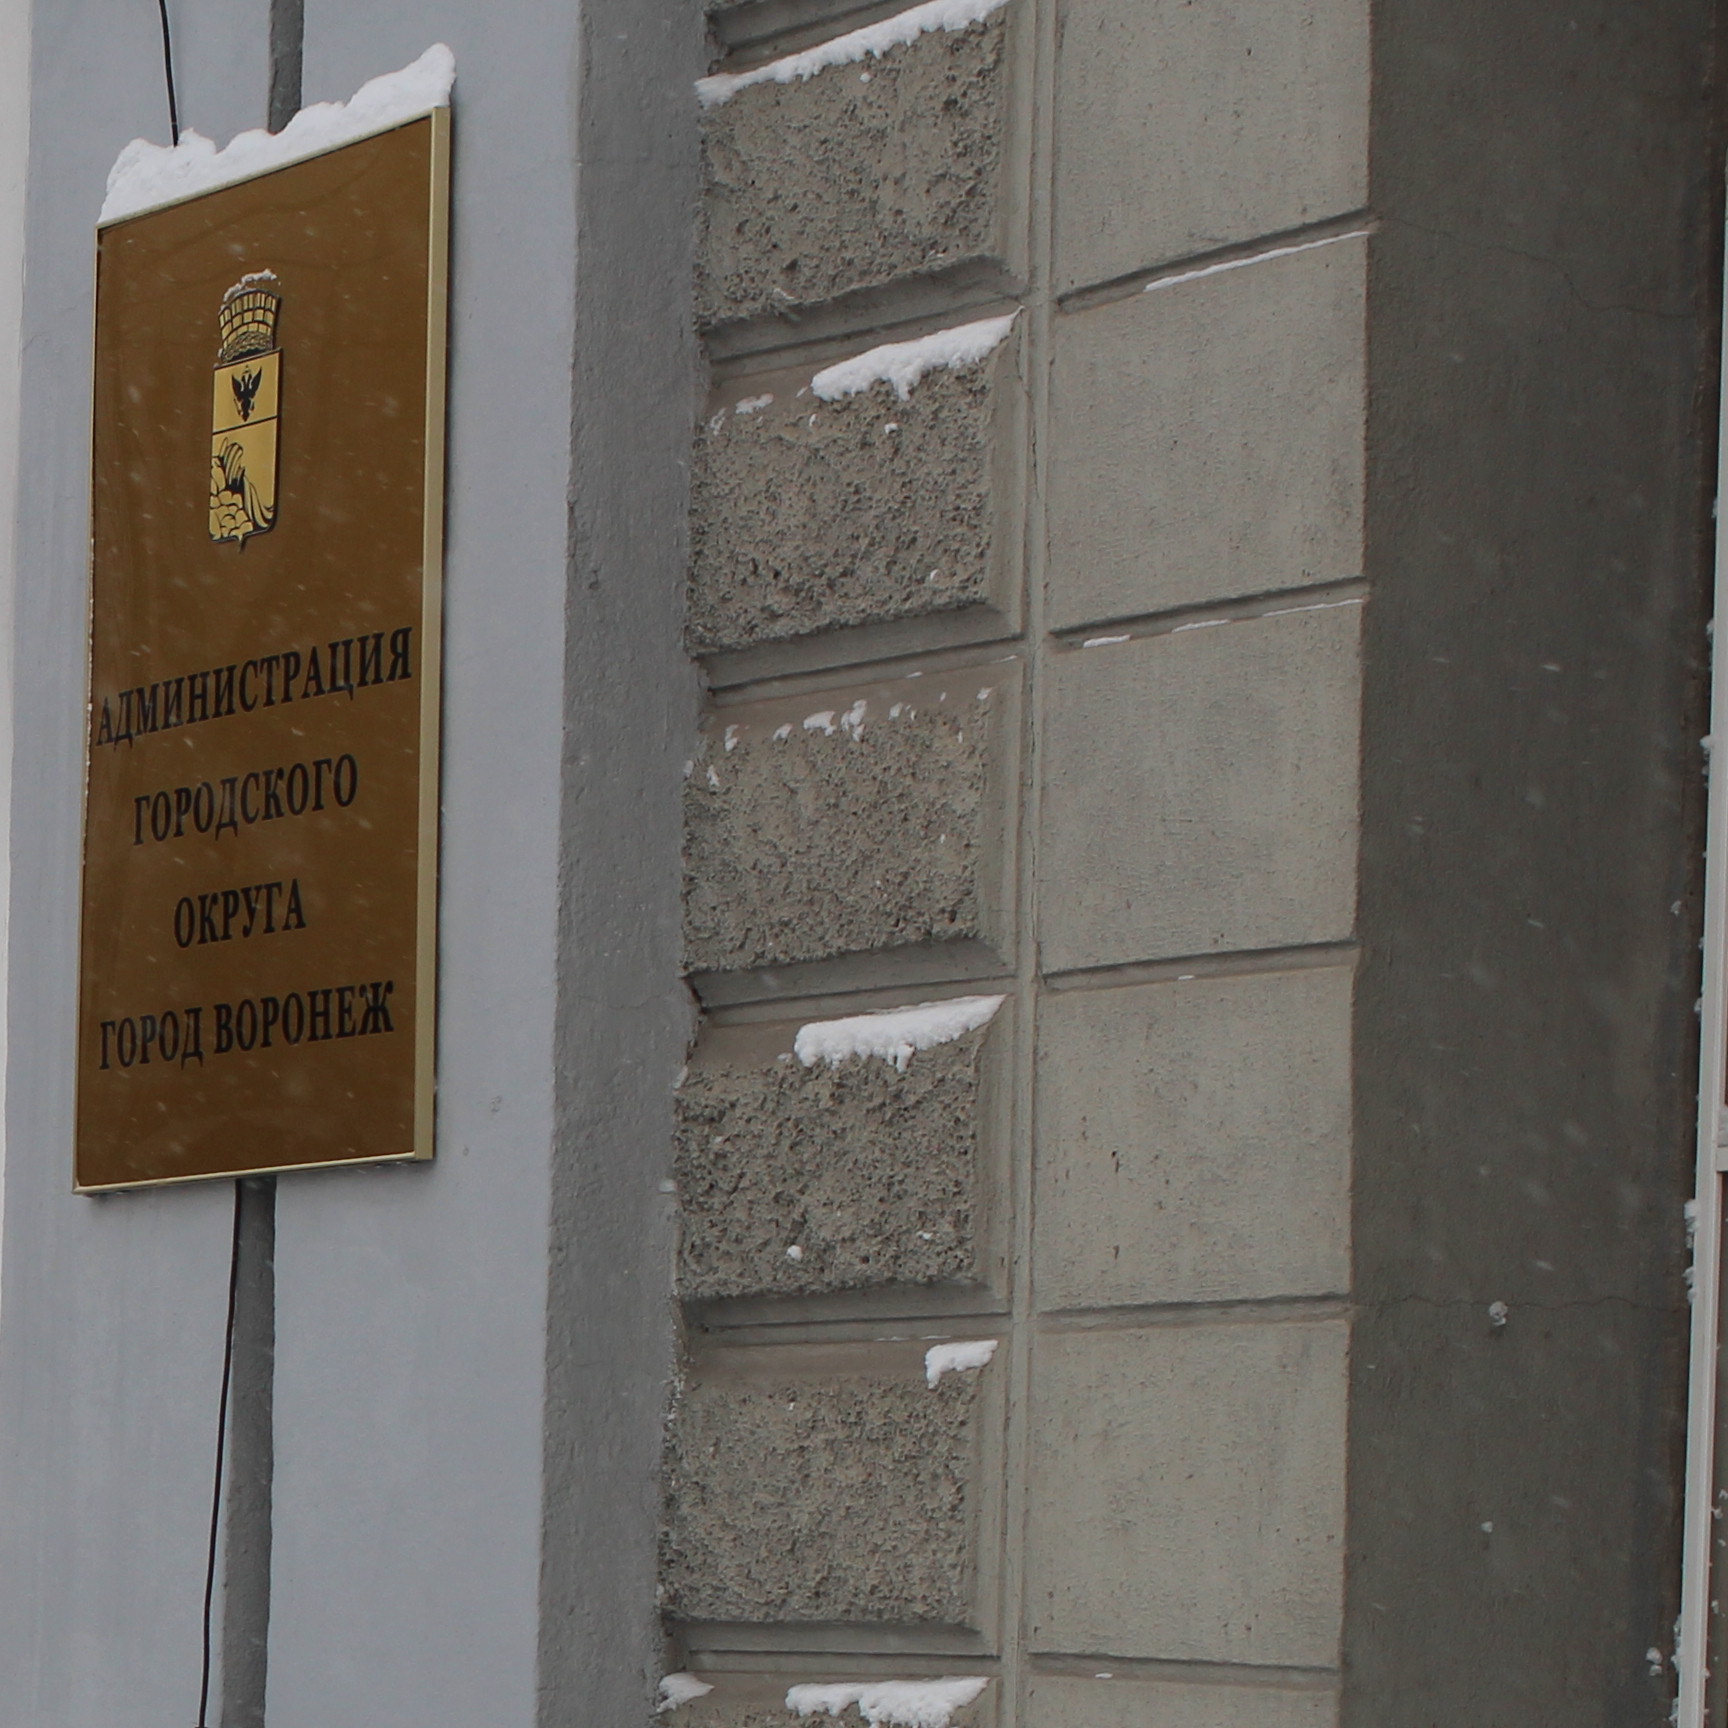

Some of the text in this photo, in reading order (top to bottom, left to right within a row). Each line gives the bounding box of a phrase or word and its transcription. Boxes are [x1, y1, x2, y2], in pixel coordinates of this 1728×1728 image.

[96, 626, 413, 750] АДМИНИСТРАЦИЯ
[133, 753, 358, 846] ГОРОДСКОГО
[174, 878, 306, 949] ОКРУГА
[98, 980, 395, 1071] ГОРОД ВОРОНЕЖ
